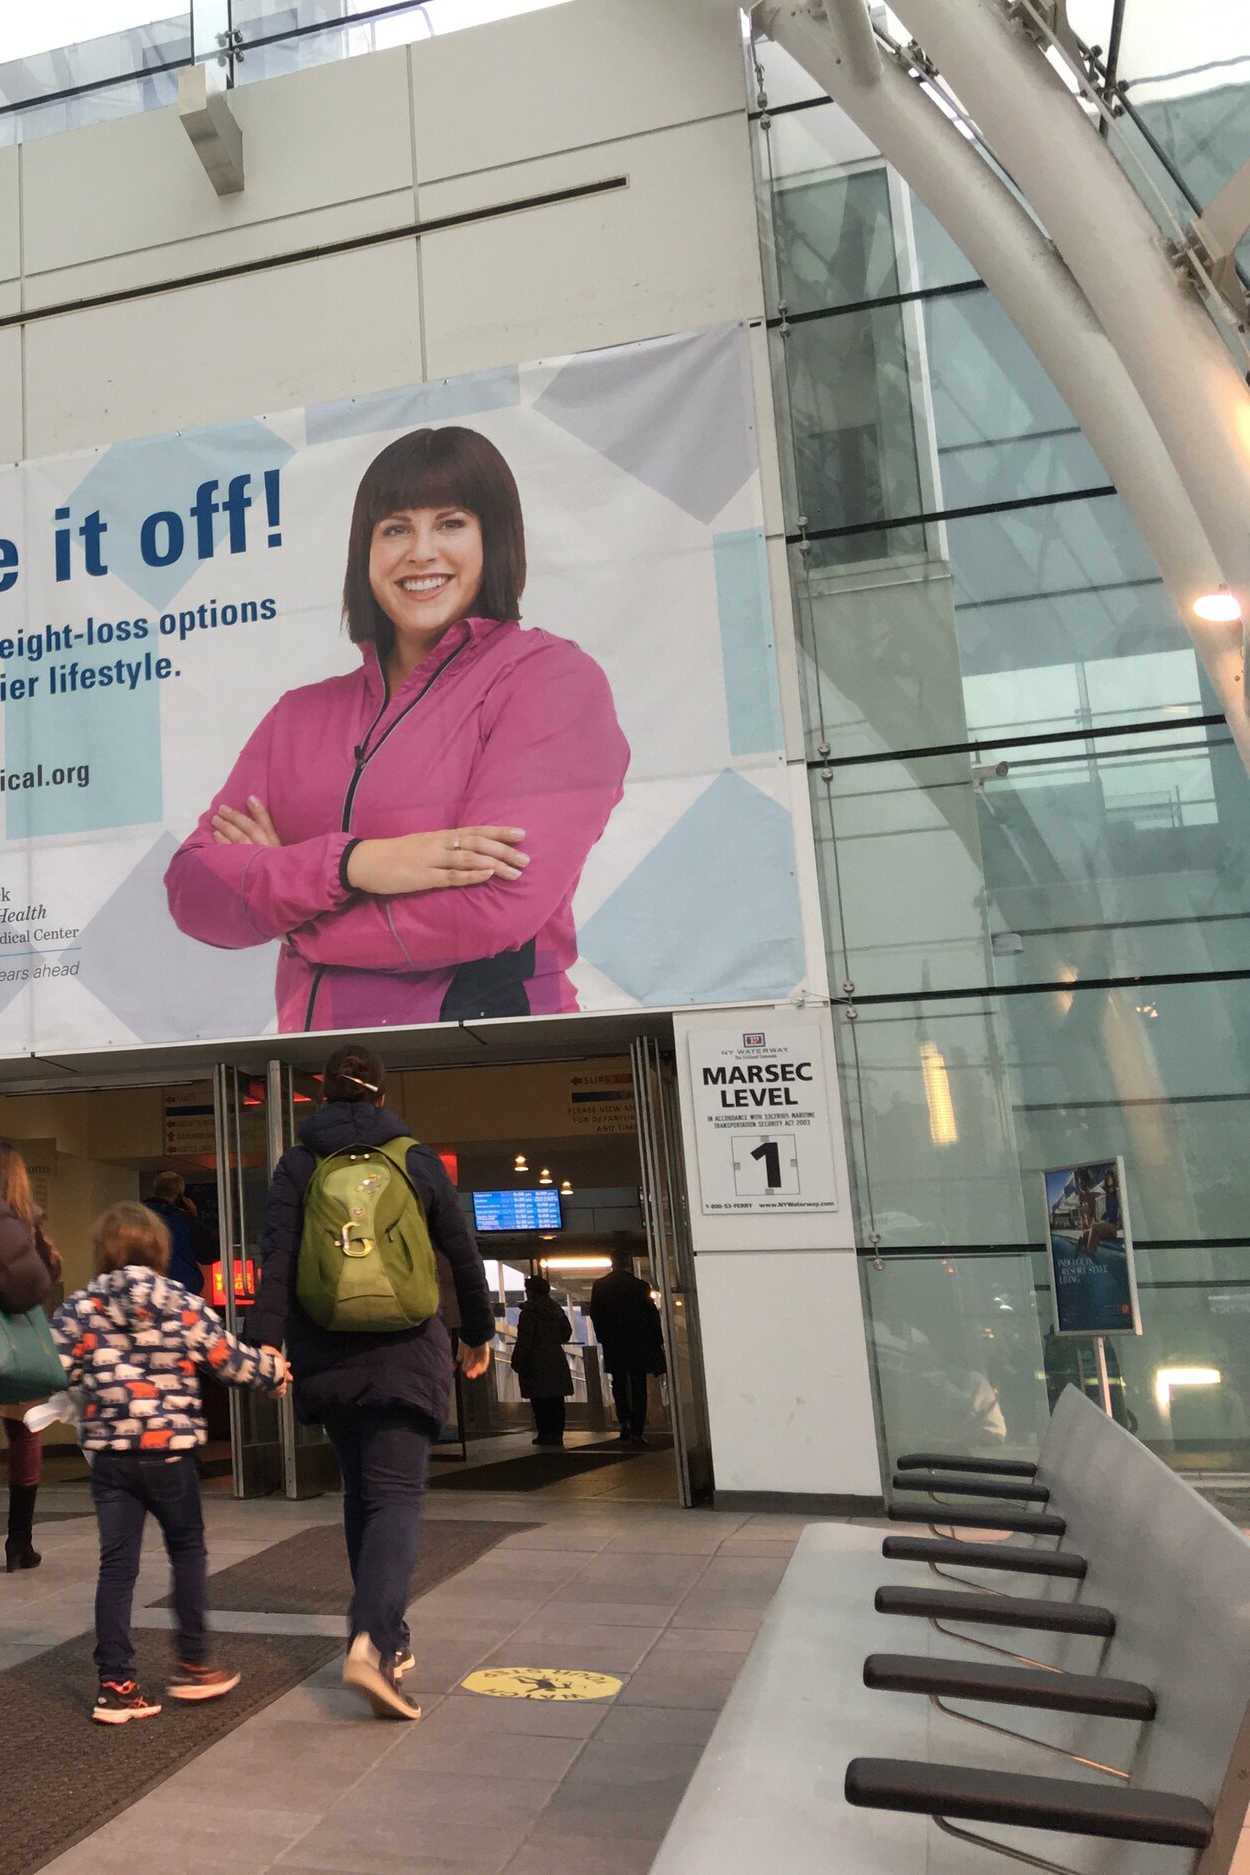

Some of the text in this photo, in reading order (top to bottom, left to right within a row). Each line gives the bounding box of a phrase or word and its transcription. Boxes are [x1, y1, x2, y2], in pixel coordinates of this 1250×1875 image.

[54, 506, 109, 583] it
[139, 468, 283, 569] off!
[158, 597, 277, 641] options
[48, 651, 182, 695] lifestyle.
[33, 926, 80, 942] Center
[32, 961, 80, 980] ahead
[737, 1046, 789, 1055] WATERWAY
[702, 1062, 813, 1086] MARSEC
[720, 1087, 798, 1108] LEVEL
[714, 1121, 757, 1129] TRANSPORTATION
[758, 1120, 783, 1128] SECURITY
[785, 1119, 795, 1127] ACT
[715, 1114, 748, 1122] ACCORDANCE
[791, 1111, 816, 1119] MARITIME
[750, 1141, 782, 1189] 1
